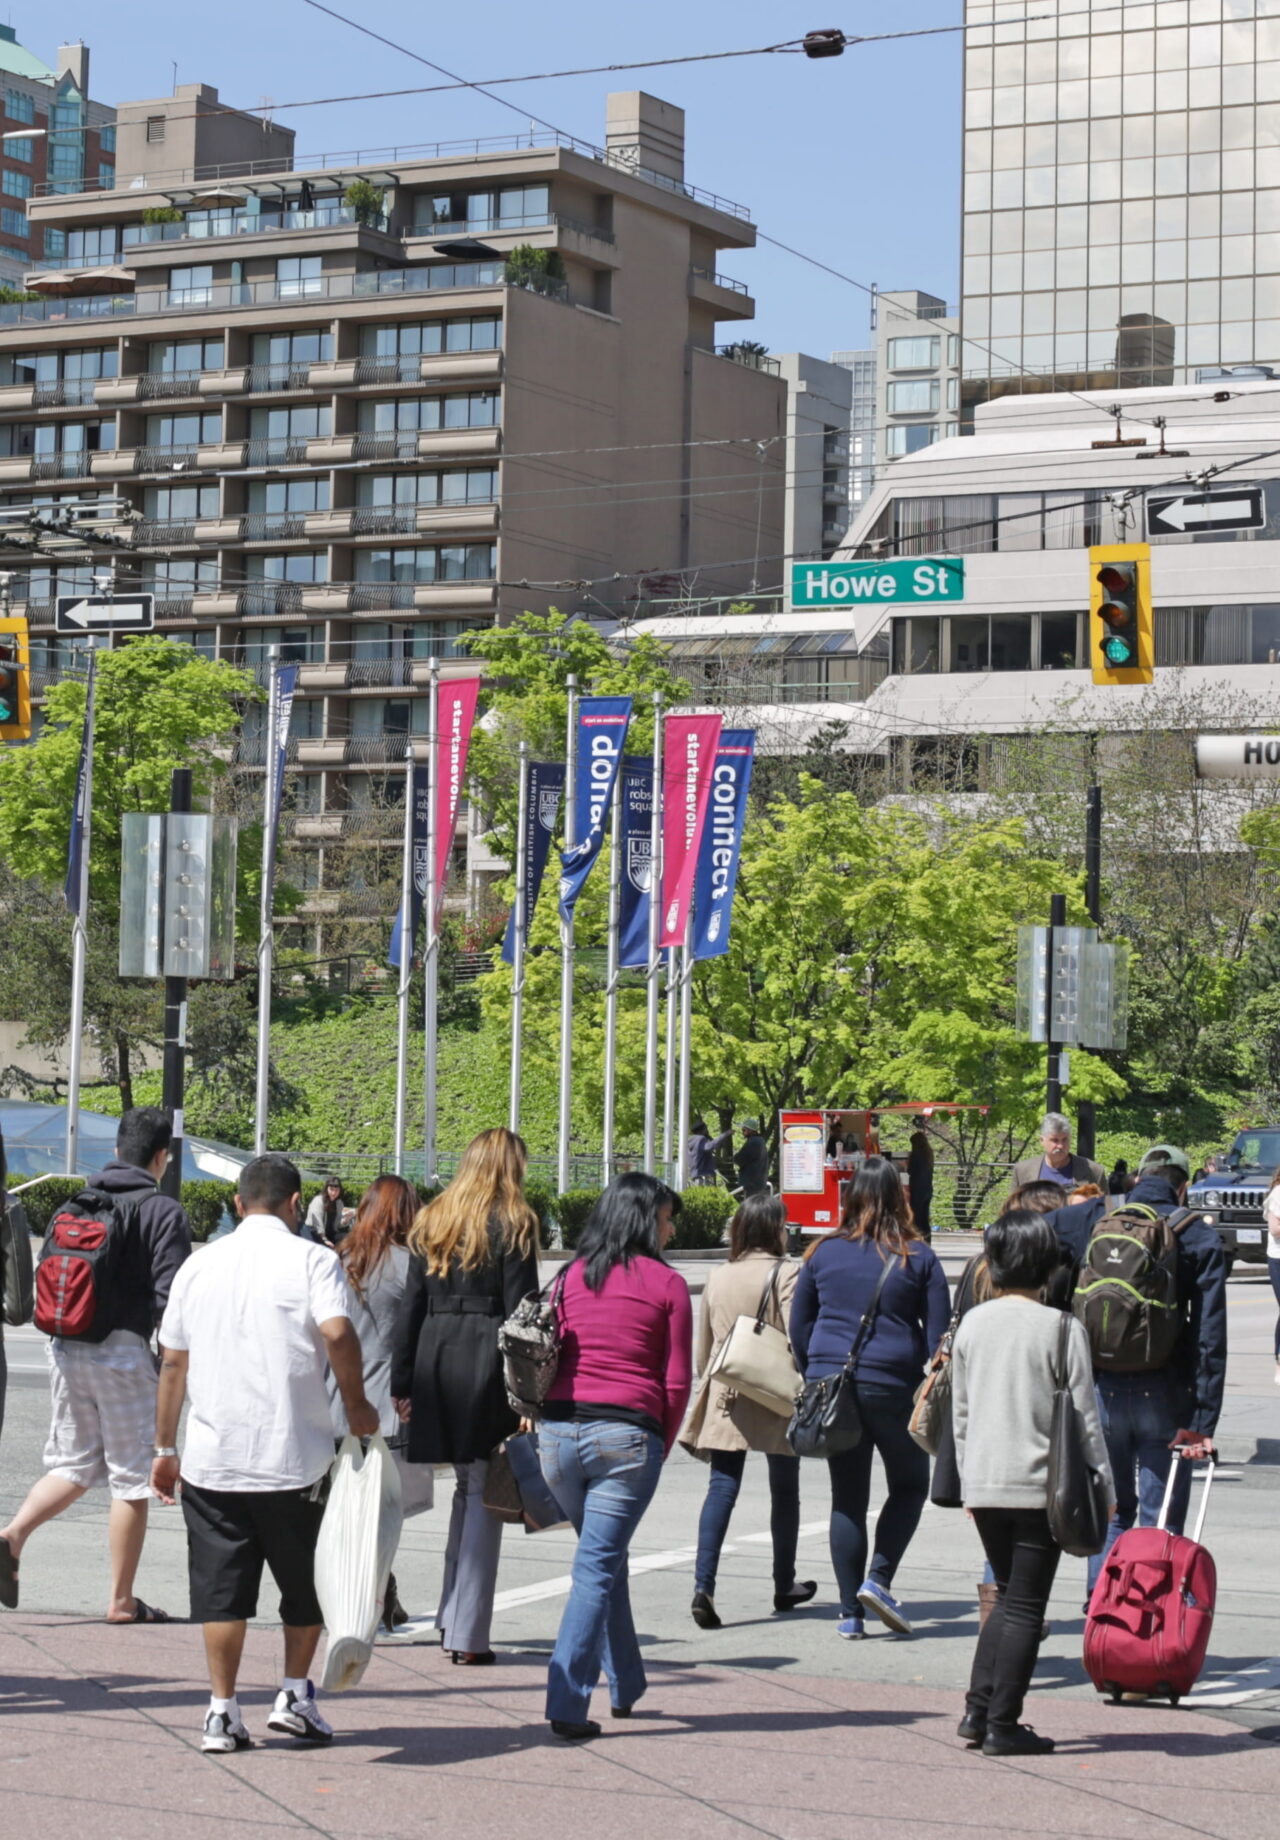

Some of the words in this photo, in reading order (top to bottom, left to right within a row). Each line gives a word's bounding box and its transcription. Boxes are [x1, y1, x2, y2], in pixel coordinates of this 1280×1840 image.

[806, 570, 897, 599] Howe
[912, 566, 949, 596] St
[1244, 741, 1280, 765] HO
[628, 778, 646, 787] UBC
[529, 768, 538, 820] COLUMBIA
[630, 789, 663, 800] robs
[630, 801, 663, 813] squ
[712, 764, 737, 900] connect
[631, 841, 652, 854] UB
